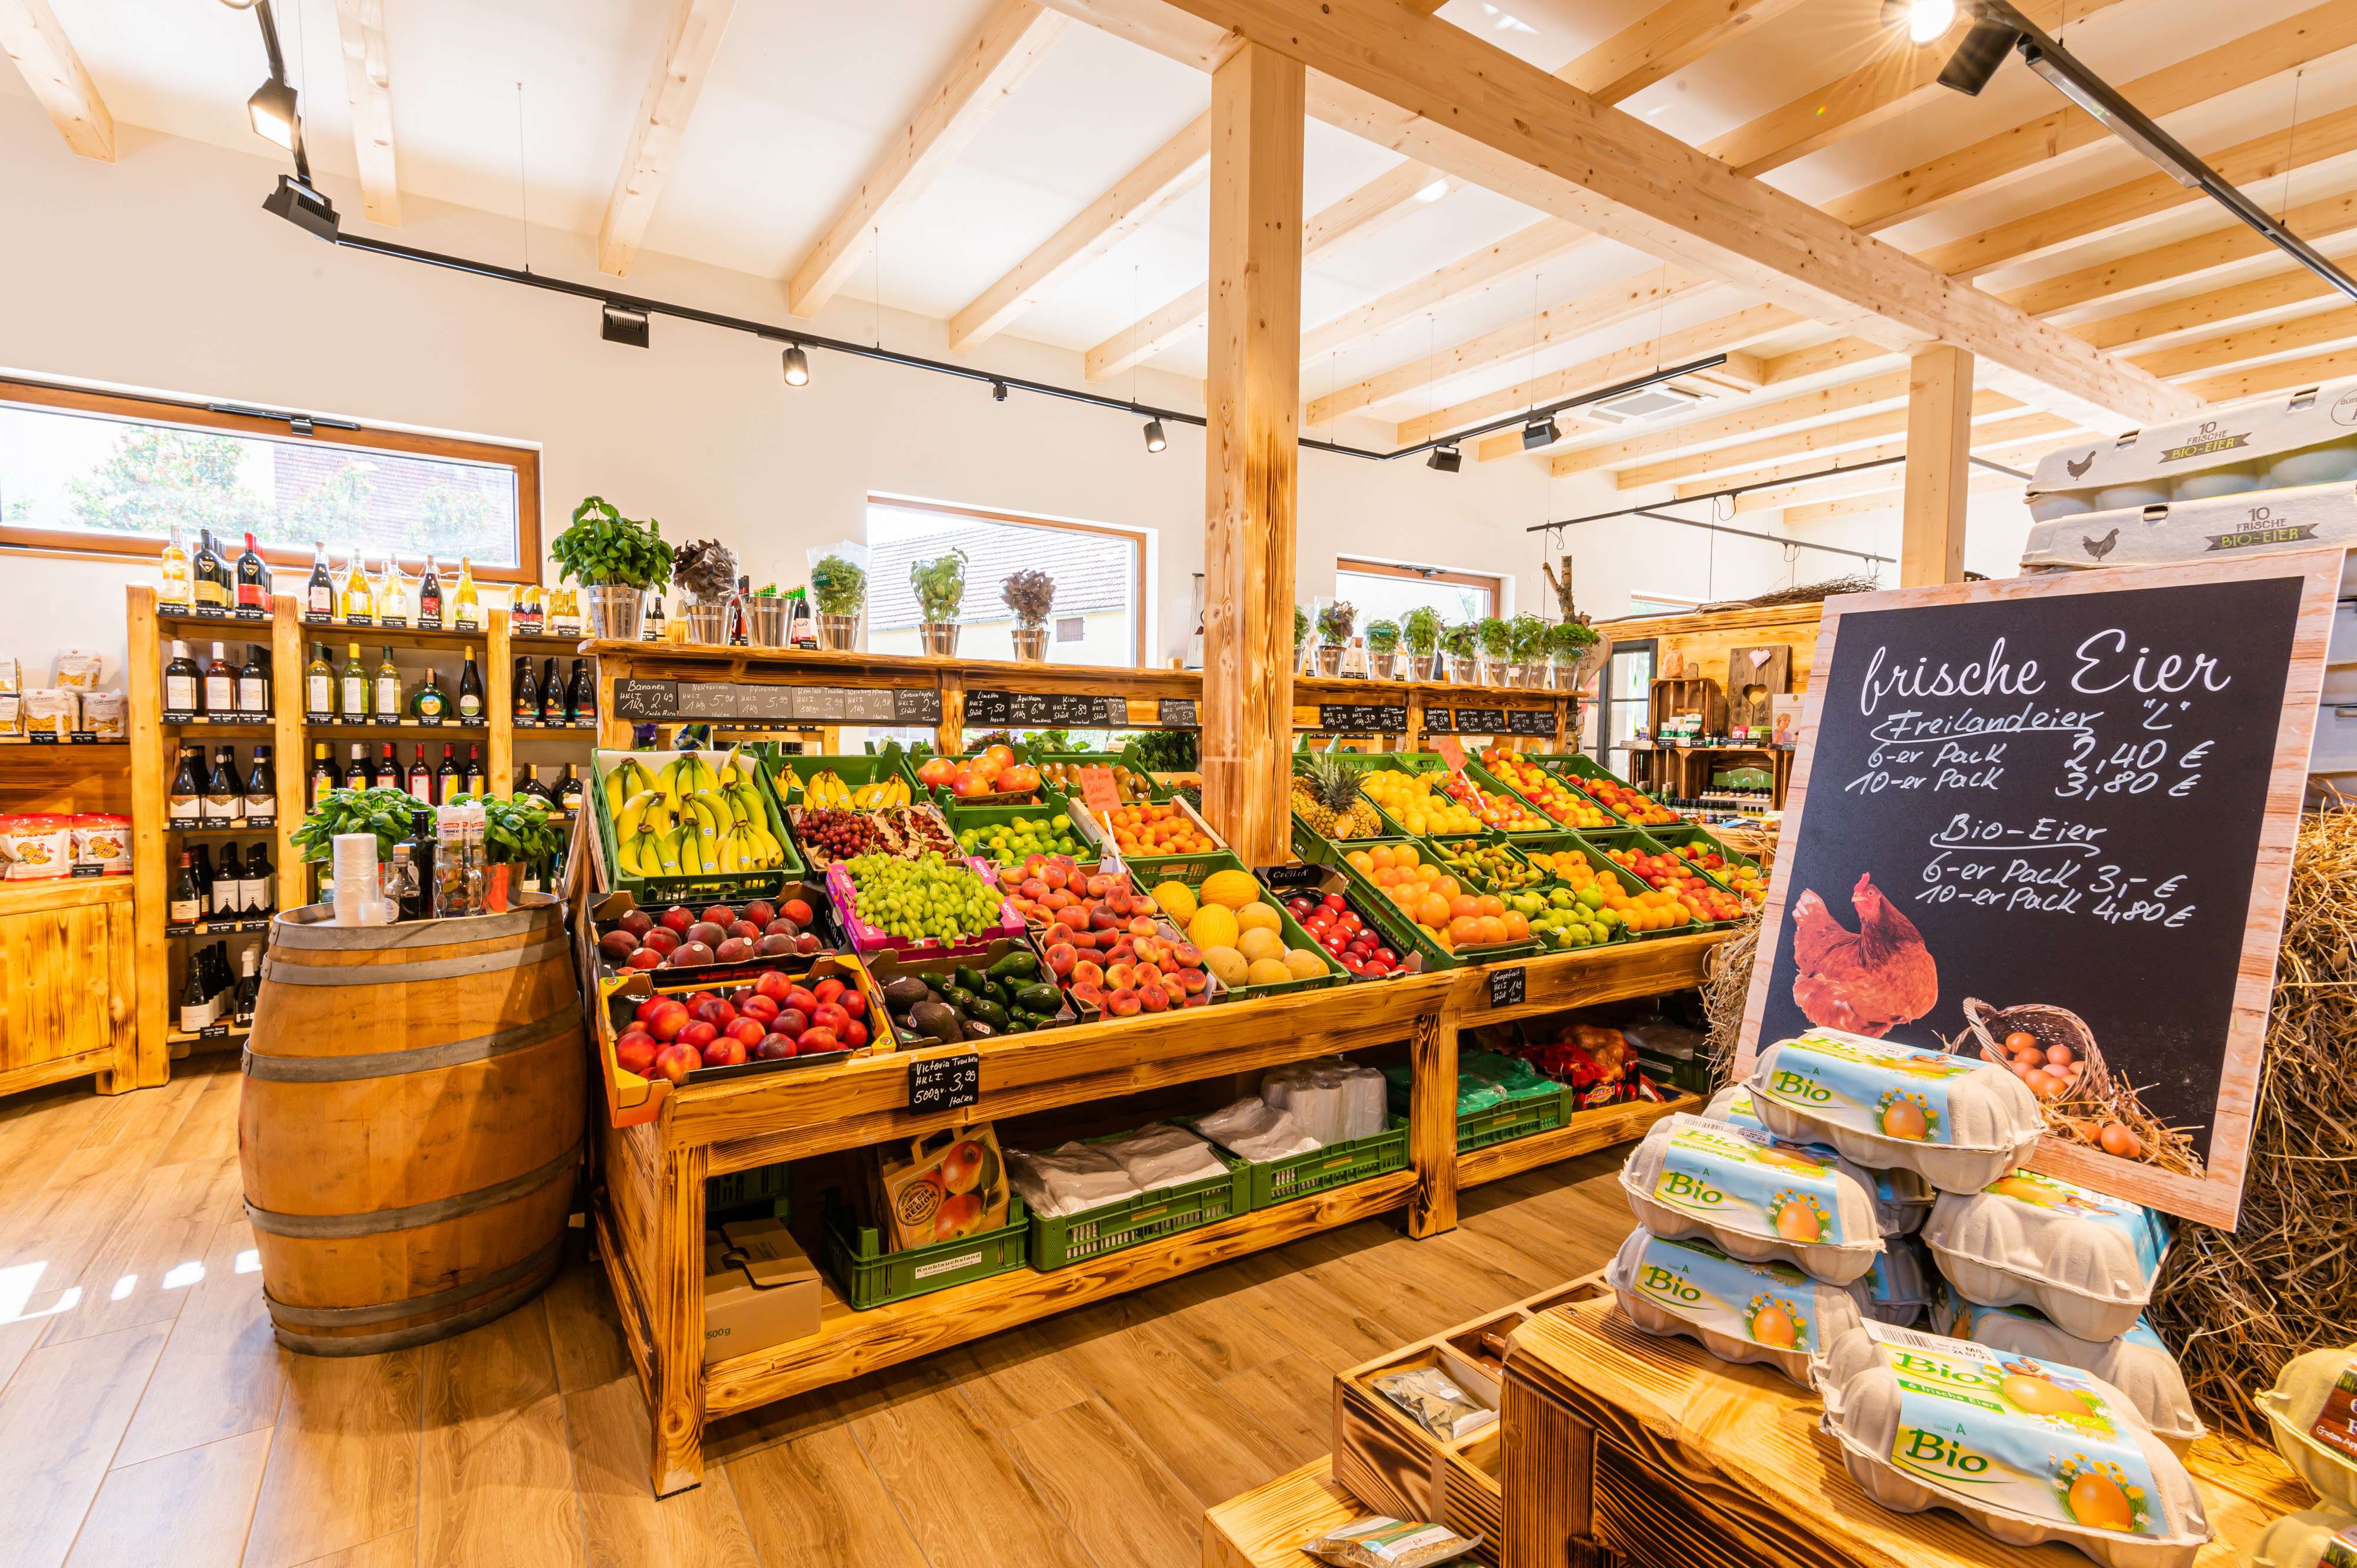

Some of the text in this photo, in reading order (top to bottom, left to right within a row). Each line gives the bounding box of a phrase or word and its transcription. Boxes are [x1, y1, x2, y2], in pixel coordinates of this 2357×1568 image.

[2187, 430, 2230, 445] FRISCHE
[2198, 422, 2217, 435] 10
[2171, 437, 2236, 459] BIO-EIER
[2248, 507, 2270, 521] 10
[2236, 518, 2287, 532] FRISCHE
[2221, 528, 2300, 547] BIO-EIER
[1860, 628, 2232, 717] frische Eier
[628, 680, 665, 692] Bananen
[692, 684, 728, 692] Nektarinen
[750, 686, 778, 694] Pfirsiche
[1889, 702, 2106, 740] Freilandeier
[1867, 735, 2216, 775] 6-er Pack 2,40 €
[1844, 767, 2203, 801] 10-er Pack 3,80 €
[1942, 813, 2108, 843] Bio-Eier
[974, 860, 989, 879] MOYCA
[1922, 850, 2189, 900] 6-er Pack 3,- €
[1002, 902, 1018, 921] MOYCA
[1914, 886, 2197, 929] 10-er Pack 4,80 €
[916, 1056, 978, 1075] Victoria Trauben
[1813, 1067, 1820, 1075] A
[949, 1070, 976, 1091] 3,99
[1776, 1071, 1831, 1101] Bio
[949, 1095, 973, 1107] Italien
[1702, 1168, 1710, 1176] A
[1665, 1171, 1722, 1203] Bio
[905, 1189, 929, 1213] AUS DER
[905, 1191, 936, 1220] REGION
[917, 1253, 980, 1272] Knoblauchsland
[1682, 1265, 1689, 1274] A
[1645, 1266, 1701, 1300] Bio
[1965, 1346, 1984, 1355] M/L
[1895, 1352, 1984, 1384] Bio
[1921, 1385, 1965, 1401] frische
[1969, 1398, 1995, 1408] Eier
[1955, 1421, 1966, 1437] A
[1904, 1426, 1990, 1474] Bio
